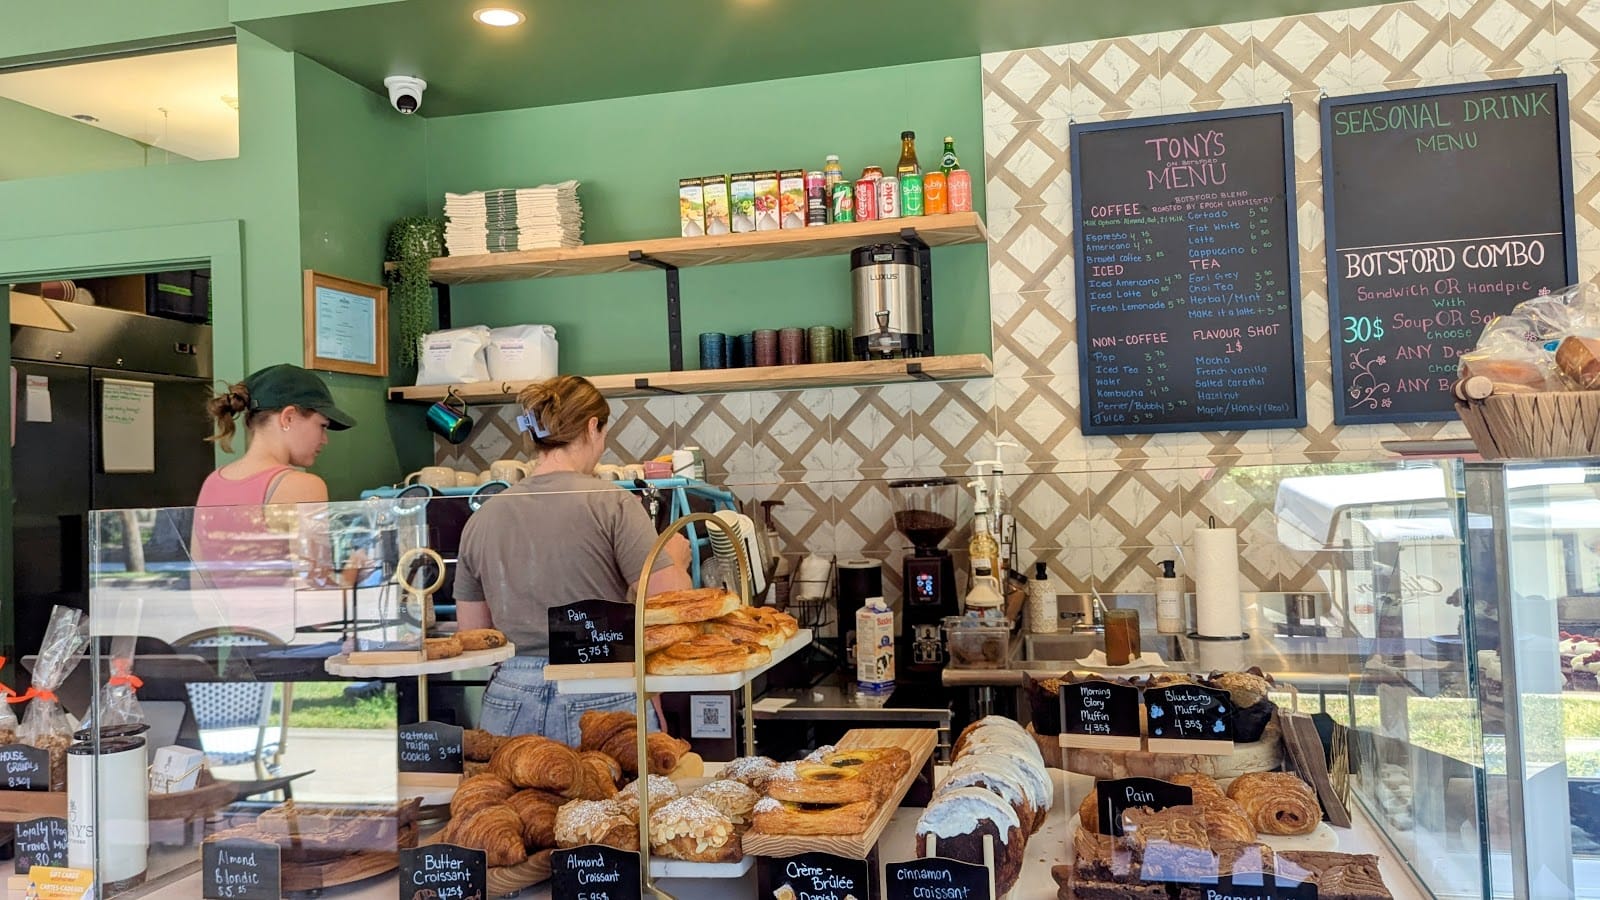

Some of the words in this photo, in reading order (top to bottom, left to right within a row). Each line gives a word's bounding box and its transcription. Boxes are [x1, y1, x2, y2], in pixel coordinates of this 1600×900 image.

[1334, 101, 1452, 135] SEASONAL
[1463, 92, 1551, 122] DRINK
[1416, 131, 1478, 152] MENU
[1146, 162, 1226, 190] MENU
[1175, 192, 1217, 203] BOTSFORD
[1220, 190, 1247, 198] BLEND
[1091, 203, 1141, 218] COFFEE
[1213, 222, 1240, 231] White
[1085, 232, 1127, 242] Espresso
[1188, 236, 1215, 245] Latte
[1086, 242, 1130, 252] Americano
[1189, 258, 1221, 270] TEA
[1344, 247, 1456, 279] BOTSFORD
[1462, 240, 1545, 269] COMBO
[870, 273, 899, 281] LUXUS
[1092, 264, 1124, 277] ICED
[1088, 280, 1112, 288] Iced
[1115, 278, 1160, 287] Americano
[1189, 272, 1210, 283] Earl
[1434, 278, 1461, 294] OR
[1090, 292, 1112, 300] Iced
[1090, 304, 1118, 312] Fresh
[1392, 313, 1433, 333] Soup
[1435, 310, 1464, 326] OR
[1193, 327, 1242, 340] FLAVOUR
[1247, 323, 1280, 338] SHOT
[1343, 315, 1384, 343] 30$
[1093, 351, 1116, 363] Pop
[1395, 344, 1432, 360] ANY
[1195, 356, 1230, 365] Mocha
[1096, 366, 1118, 374] Iced
[1396, 378, 1430, 392] ANY
[1097, 389, 1144, 397] Kombucha
[1093, 411, 1125, 424] Juice
[567, 609, 587, 621] Pain
[591, 629, 624, 642] Raisins
[1080, 686, 1111, 699] Morning
[1165, 690, 1211, 706] Blueberry
[1084, 698, 1105, 710] Glory
[1174, 704, 1205, 715] Muffin
[1081, 710, 1110, 722] Muffin
[1125, 786, 1154, 802] Pain
[17, 821, 48, 841] Loyalty
[17, 841, 50, 852] Travel
[218, 849, 257, 867] Almond
[424, 853, 464, 871] Butter
[567, 852, 605, 869] Almond
[413, 867, 471, 885] Croissant
[786, 861, 823, 878] Crème
[897, 868, 952, 882] cinnamon
[578, 869, 620, 885] Croissant
[811, 874, 854, 891] Brûlée
